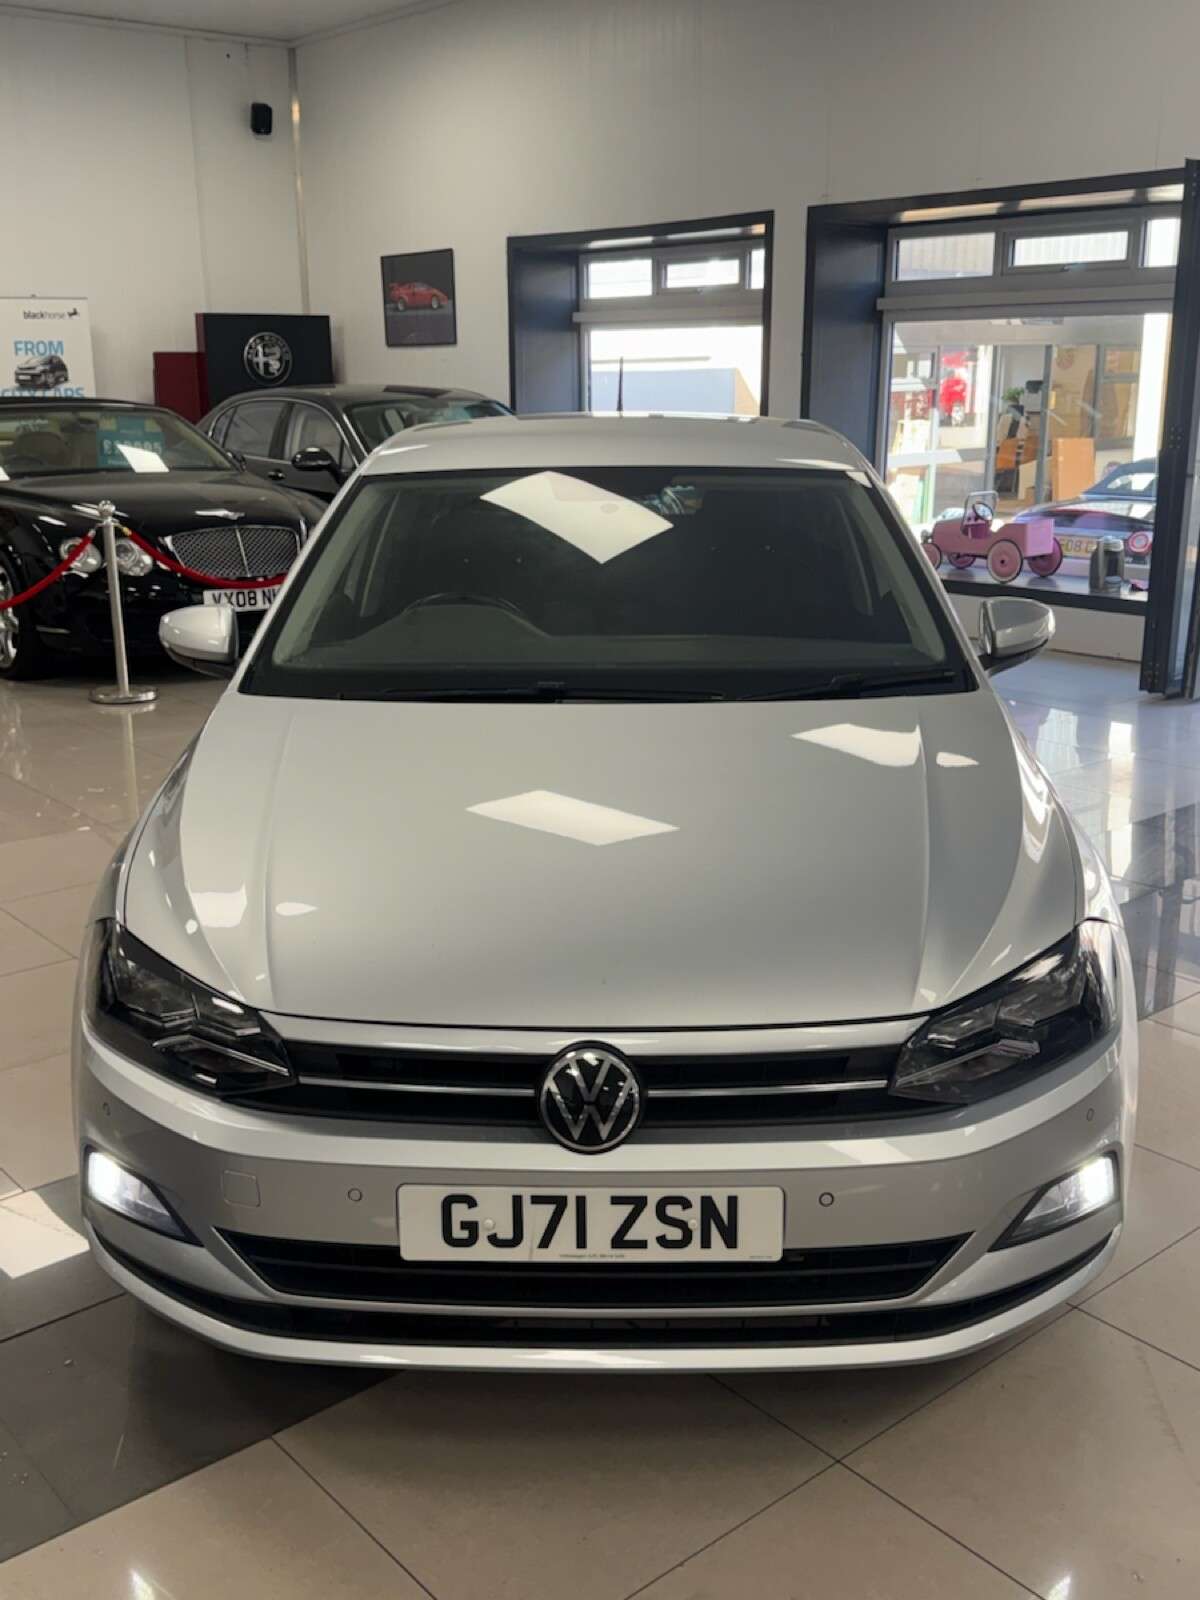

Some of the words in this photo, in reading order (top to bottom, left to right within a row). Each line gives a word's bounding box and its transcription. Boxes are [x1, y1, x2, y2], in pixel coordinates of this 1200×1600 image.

[14, 340, 64, 356] FROM
[441, 1194, 587, 1249] GJ71
[610, 1195, 739, 1249] ZSN
